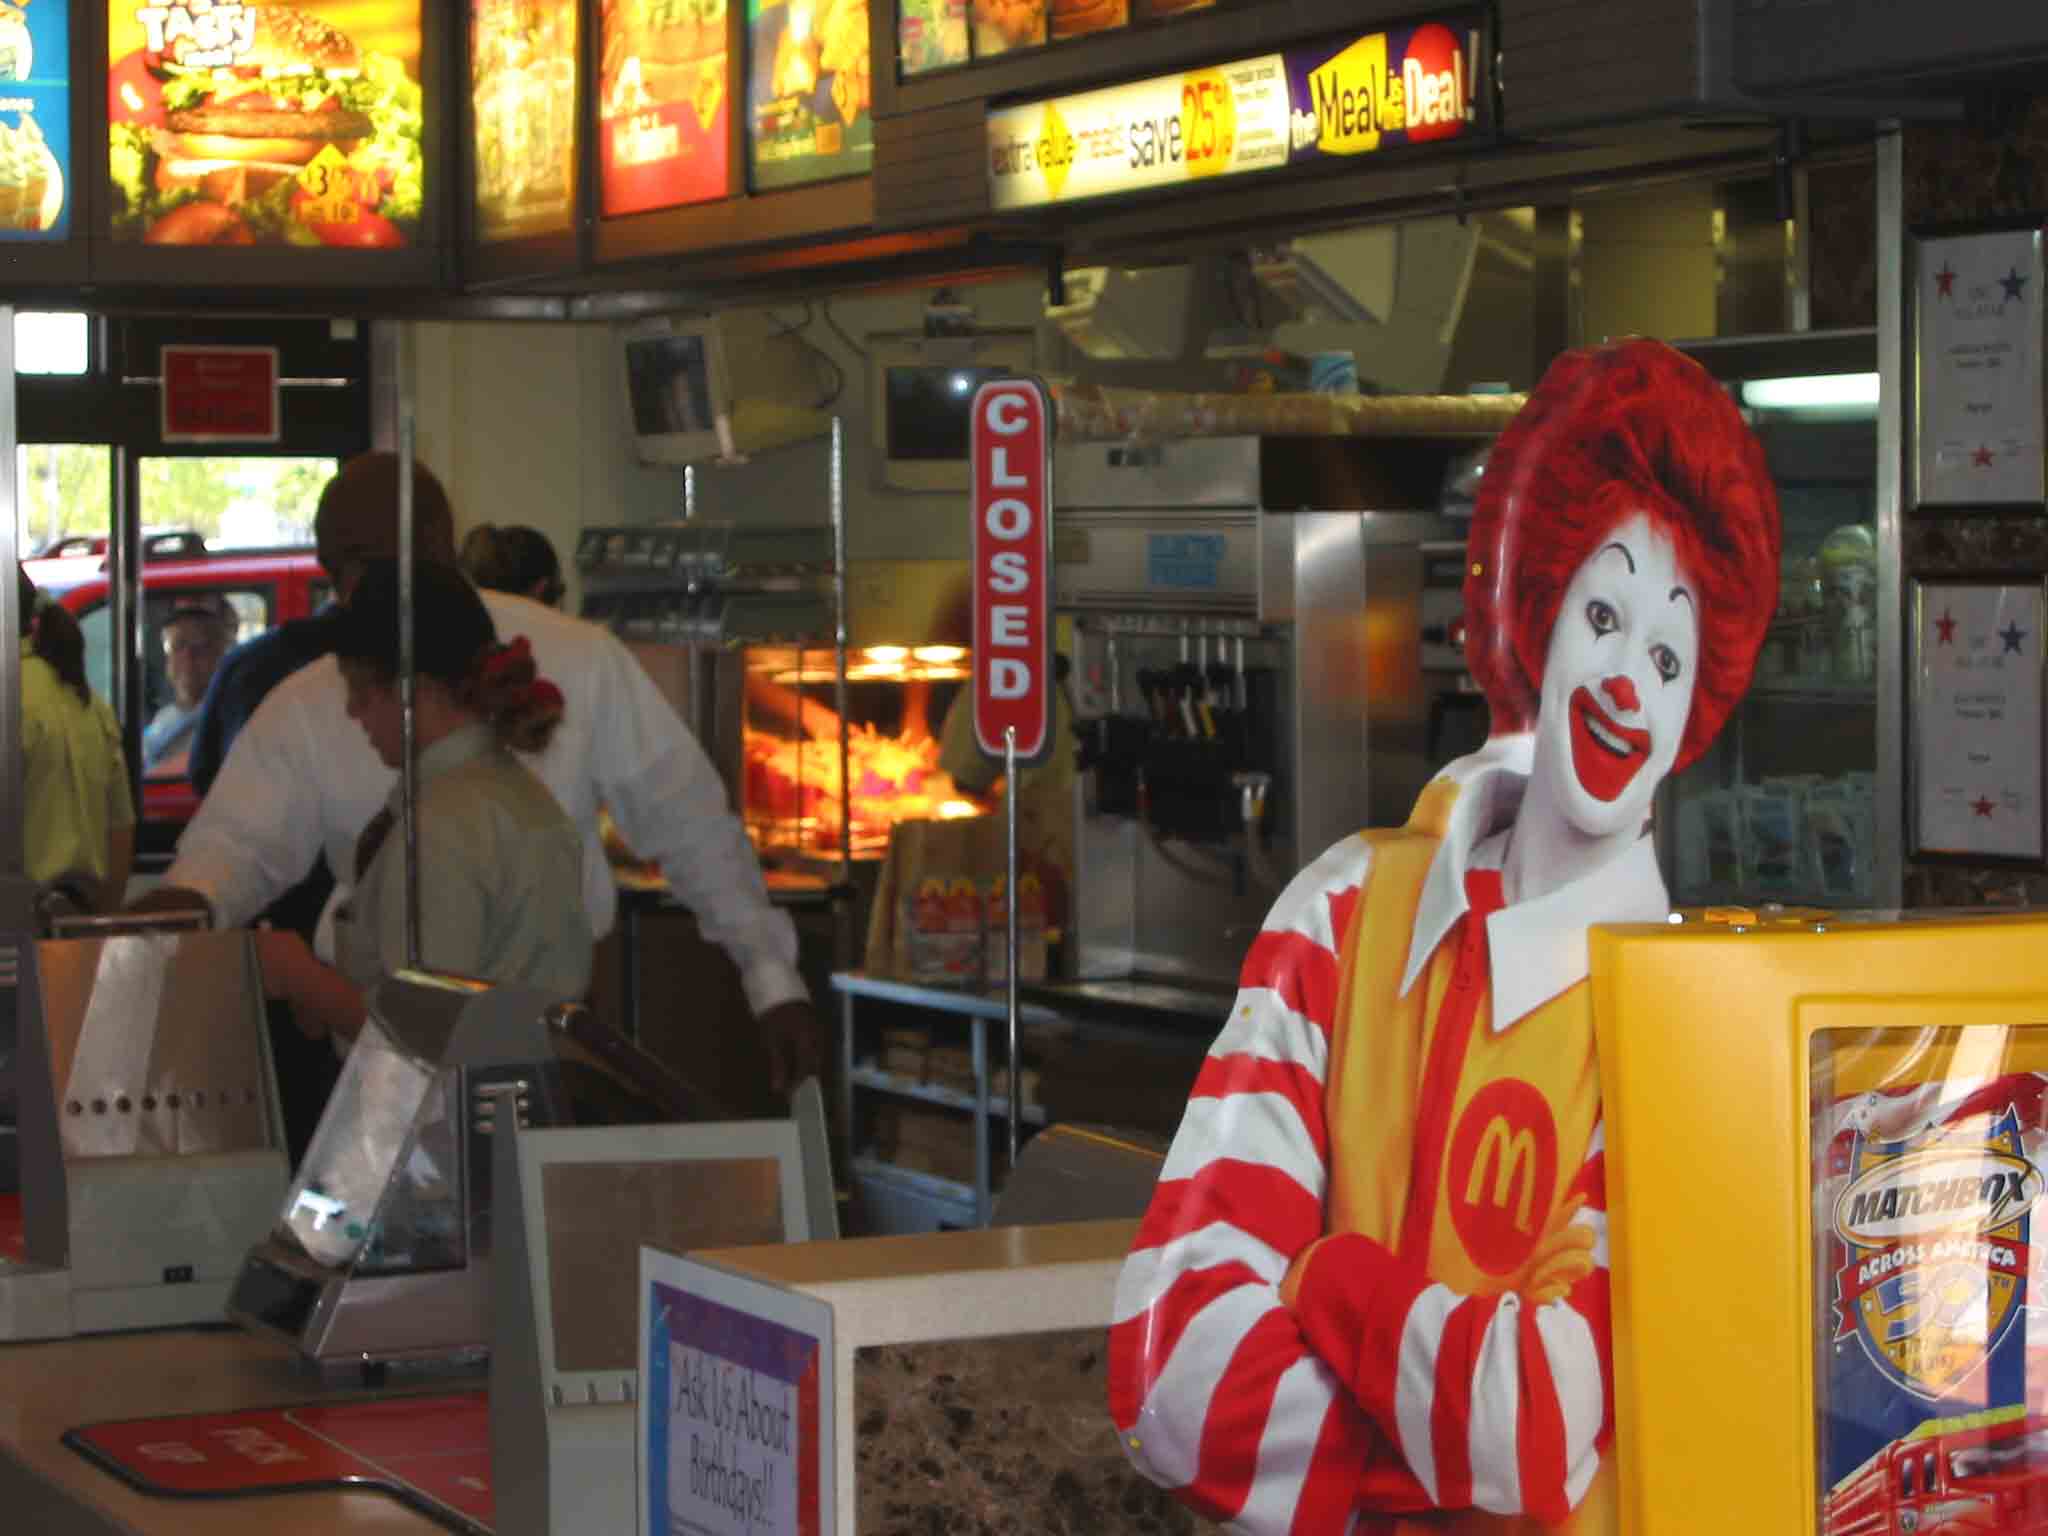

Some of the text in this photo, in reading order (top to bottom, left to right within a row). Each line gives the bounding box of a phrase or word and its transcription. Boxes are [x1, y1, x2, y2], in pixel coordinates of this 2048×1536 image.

[1316, 64, 1383, 140] Meal
[1129, 114, 1182, 169] save
[985, 393, 1032, 699] CLOSED
[1848, 1170, 2025, 1227] MATCHBOX
[1858, 1239, 1930, 1285] ACROSS
[674, 1355, 791, 1457] Ask Us About
